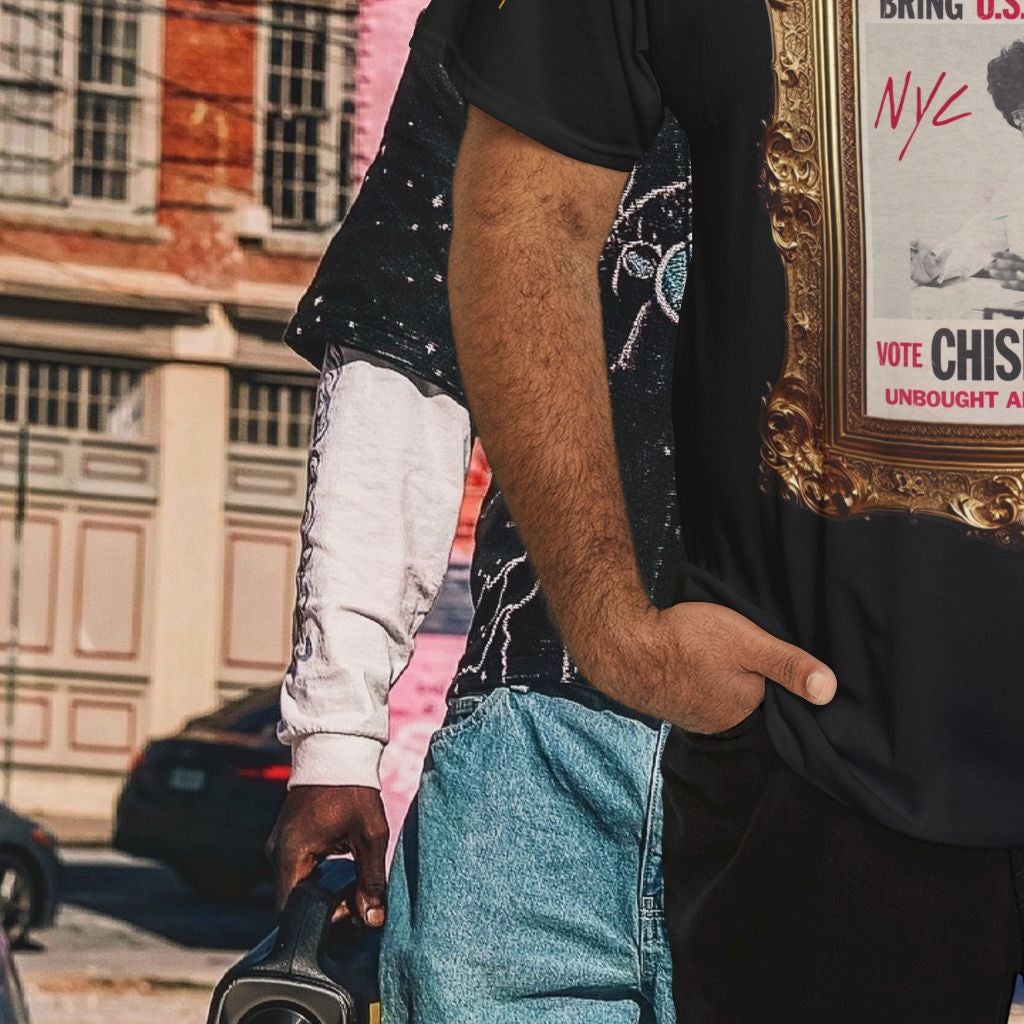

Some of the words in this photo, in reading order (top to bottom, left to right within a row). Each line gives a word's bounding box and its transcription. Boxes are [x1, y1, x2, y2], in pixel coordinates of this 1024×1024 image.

[874, 71, 972, 161] NYC
[876, 341, 923, 369] VOTE
[885, 388, 999, 409] UNBOUGHT
